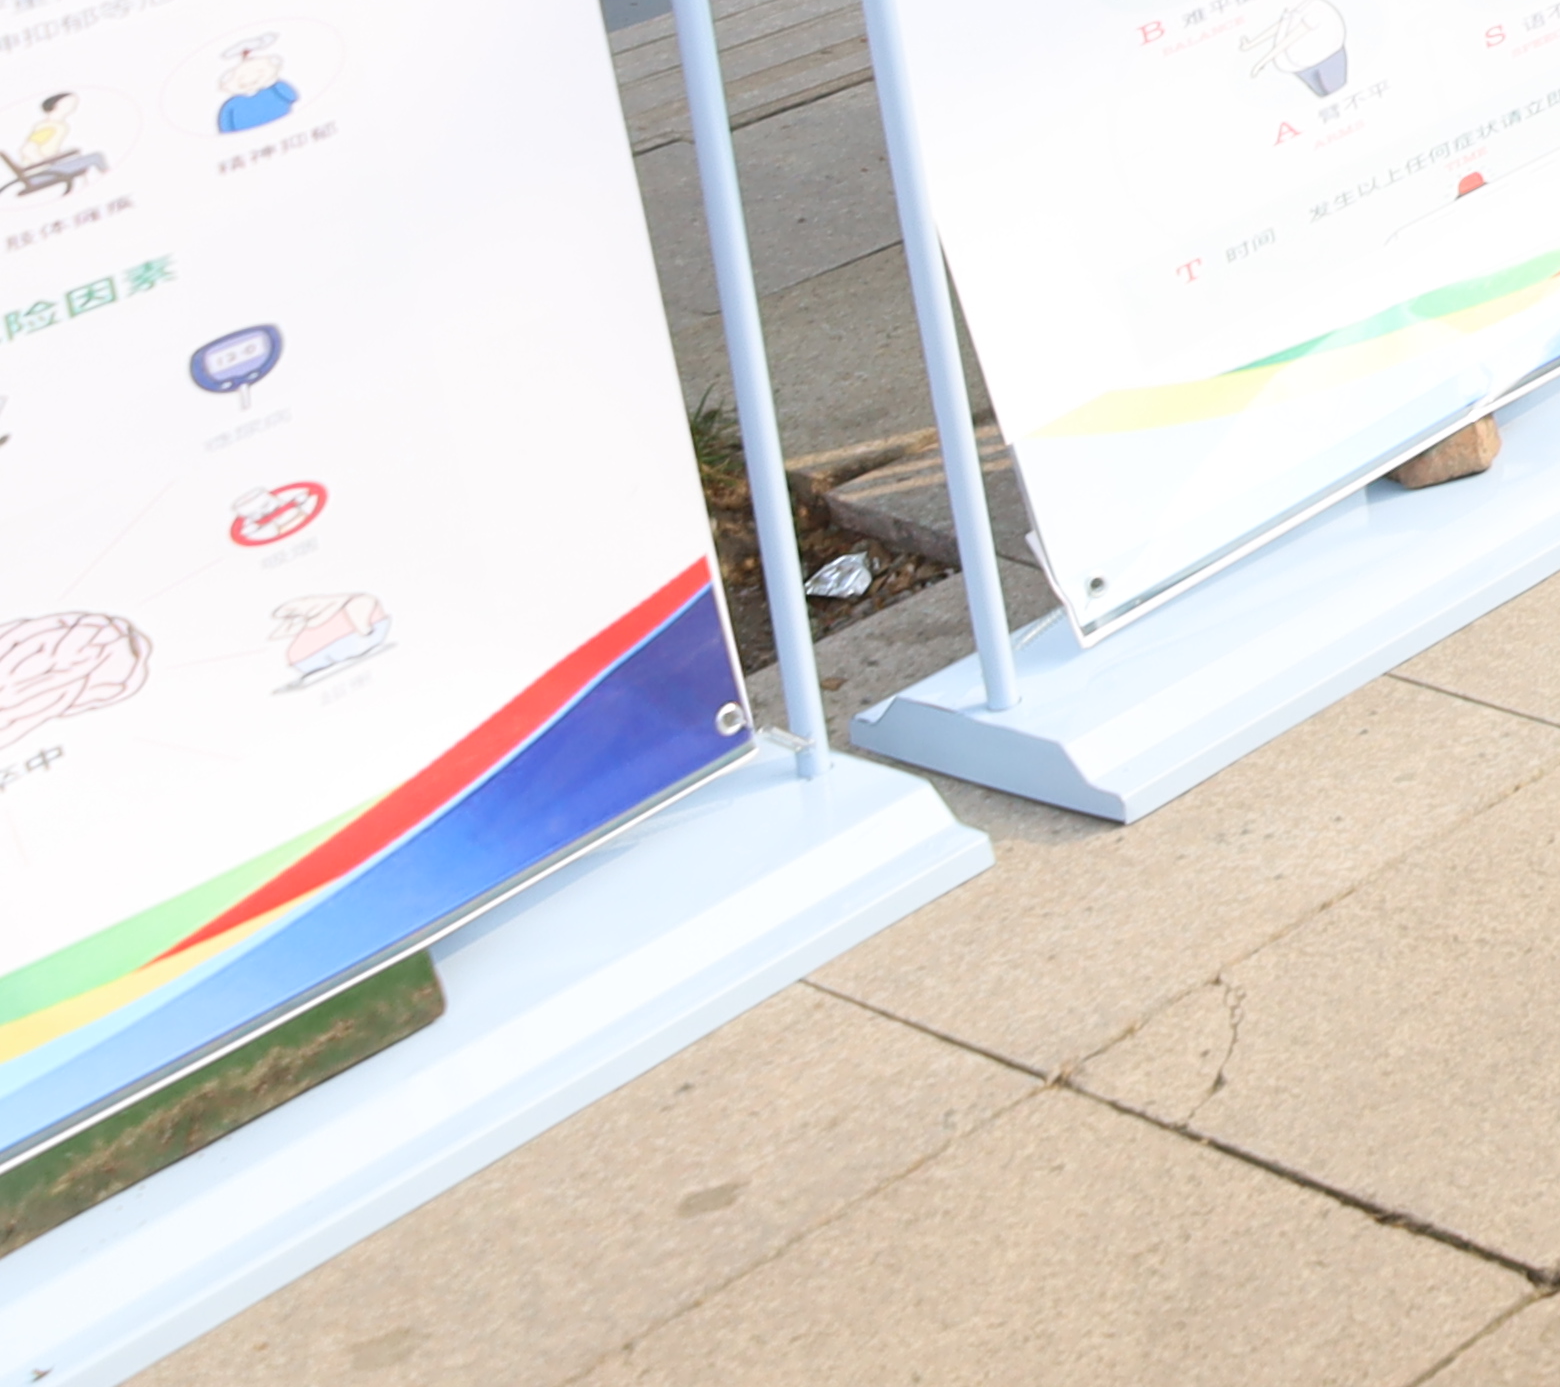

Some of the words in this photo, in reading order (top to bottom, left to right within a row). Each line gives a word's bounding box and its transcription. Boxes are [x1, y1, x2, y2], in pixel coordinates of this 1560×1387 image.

[1136, 19, 1167, 47] B
[1482, 23, 1508, 50] S
[1272, 120, 1304, 147] A
[1317, 77, 1392, 126] 臂不平
[1175, 256, 1204, 285] T
[1224, 227, 1278, 266] 时间
